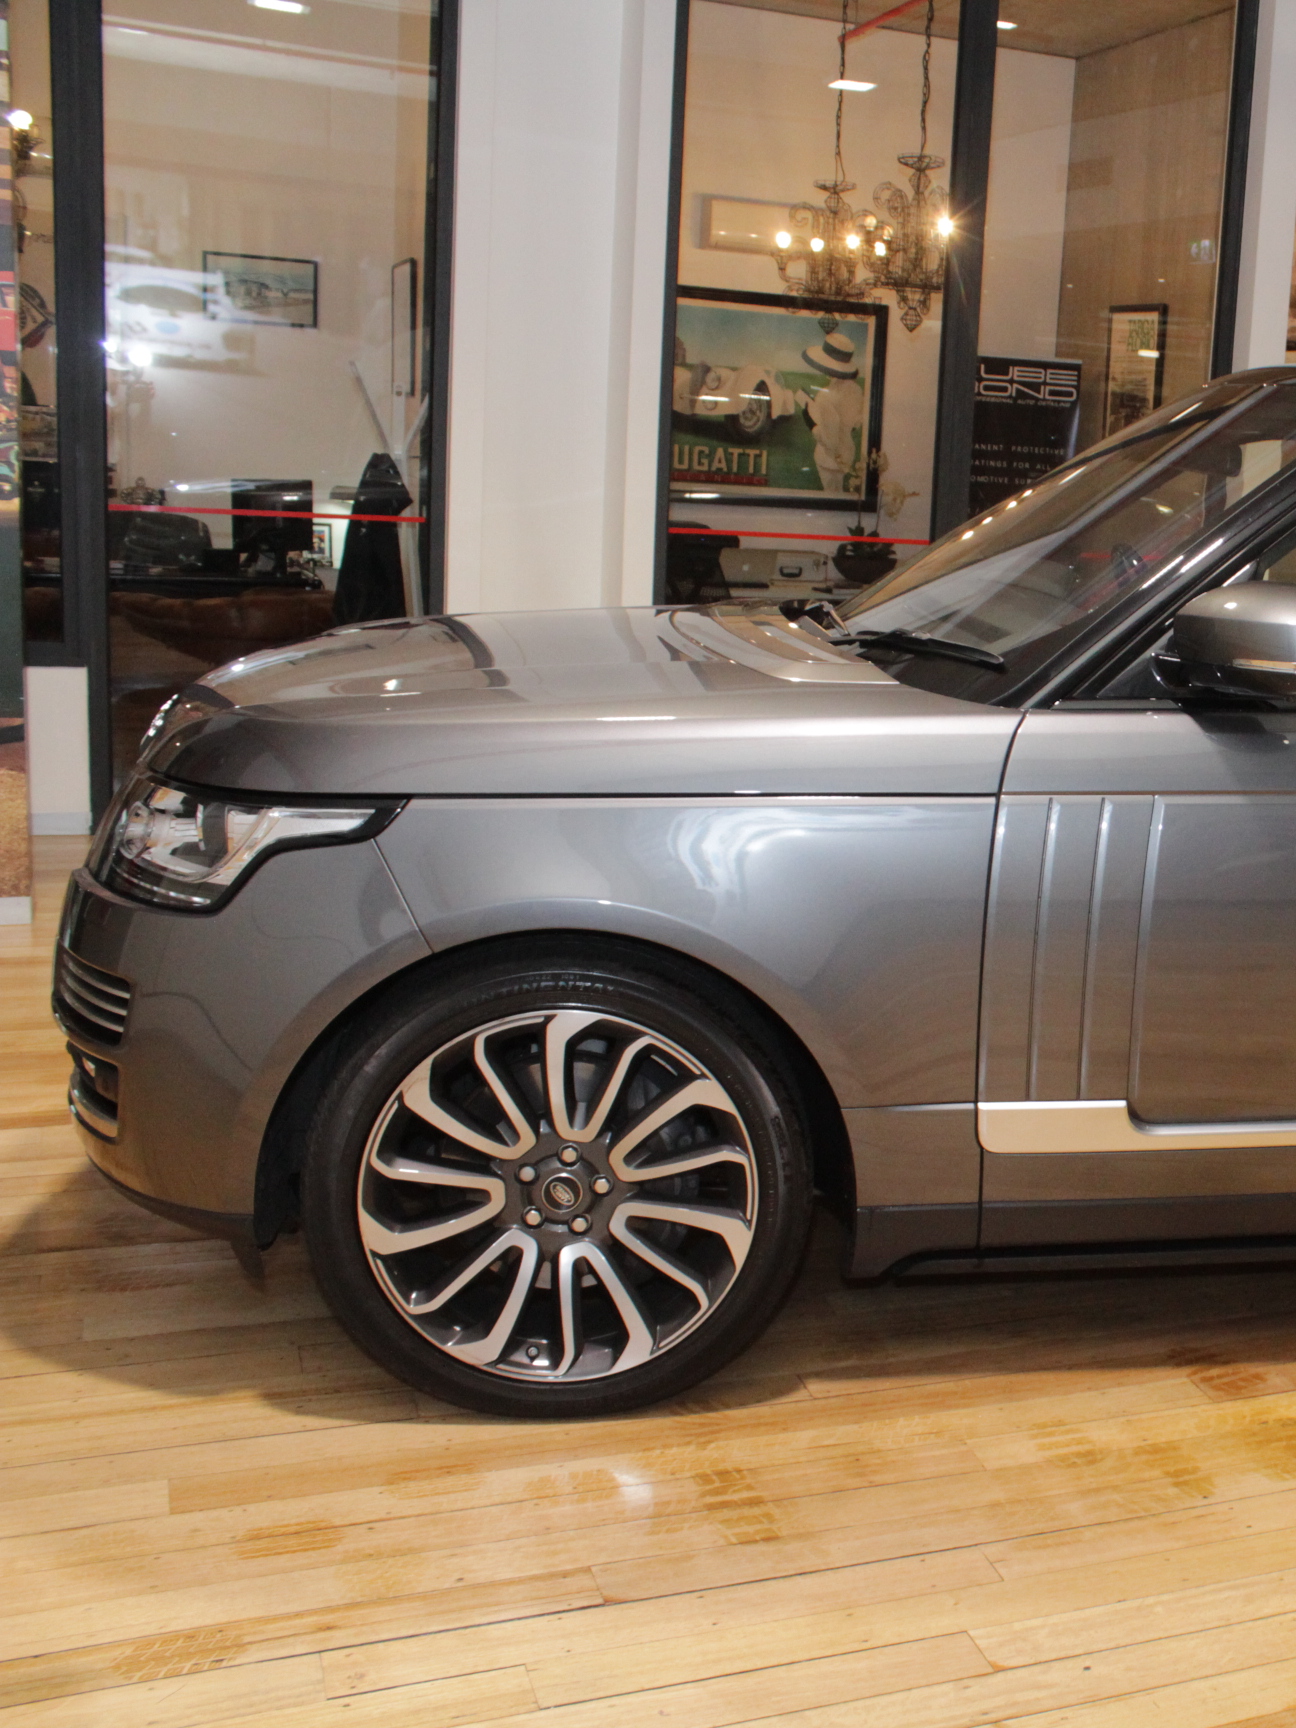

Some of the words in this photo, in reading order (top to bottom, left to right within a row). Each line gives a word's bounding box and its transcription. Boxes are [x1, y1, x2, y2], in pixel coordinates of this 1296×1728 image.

[980, 363, 1078, 386] UBE
[974, 380, 1077, 402] OND
[974, 443, 1004, 452] ANENT
[1011, 445, 1065, 456] PROTECTIVE
[673, 444, 767, 474] UGATTI
[972, 459, 1008, 468] ATINGS
[1013, 461, 1031, 469] FOR
[1036, 463, 1051, 471] ALL
[969, 474, 1009, 485] OMOTIVE
